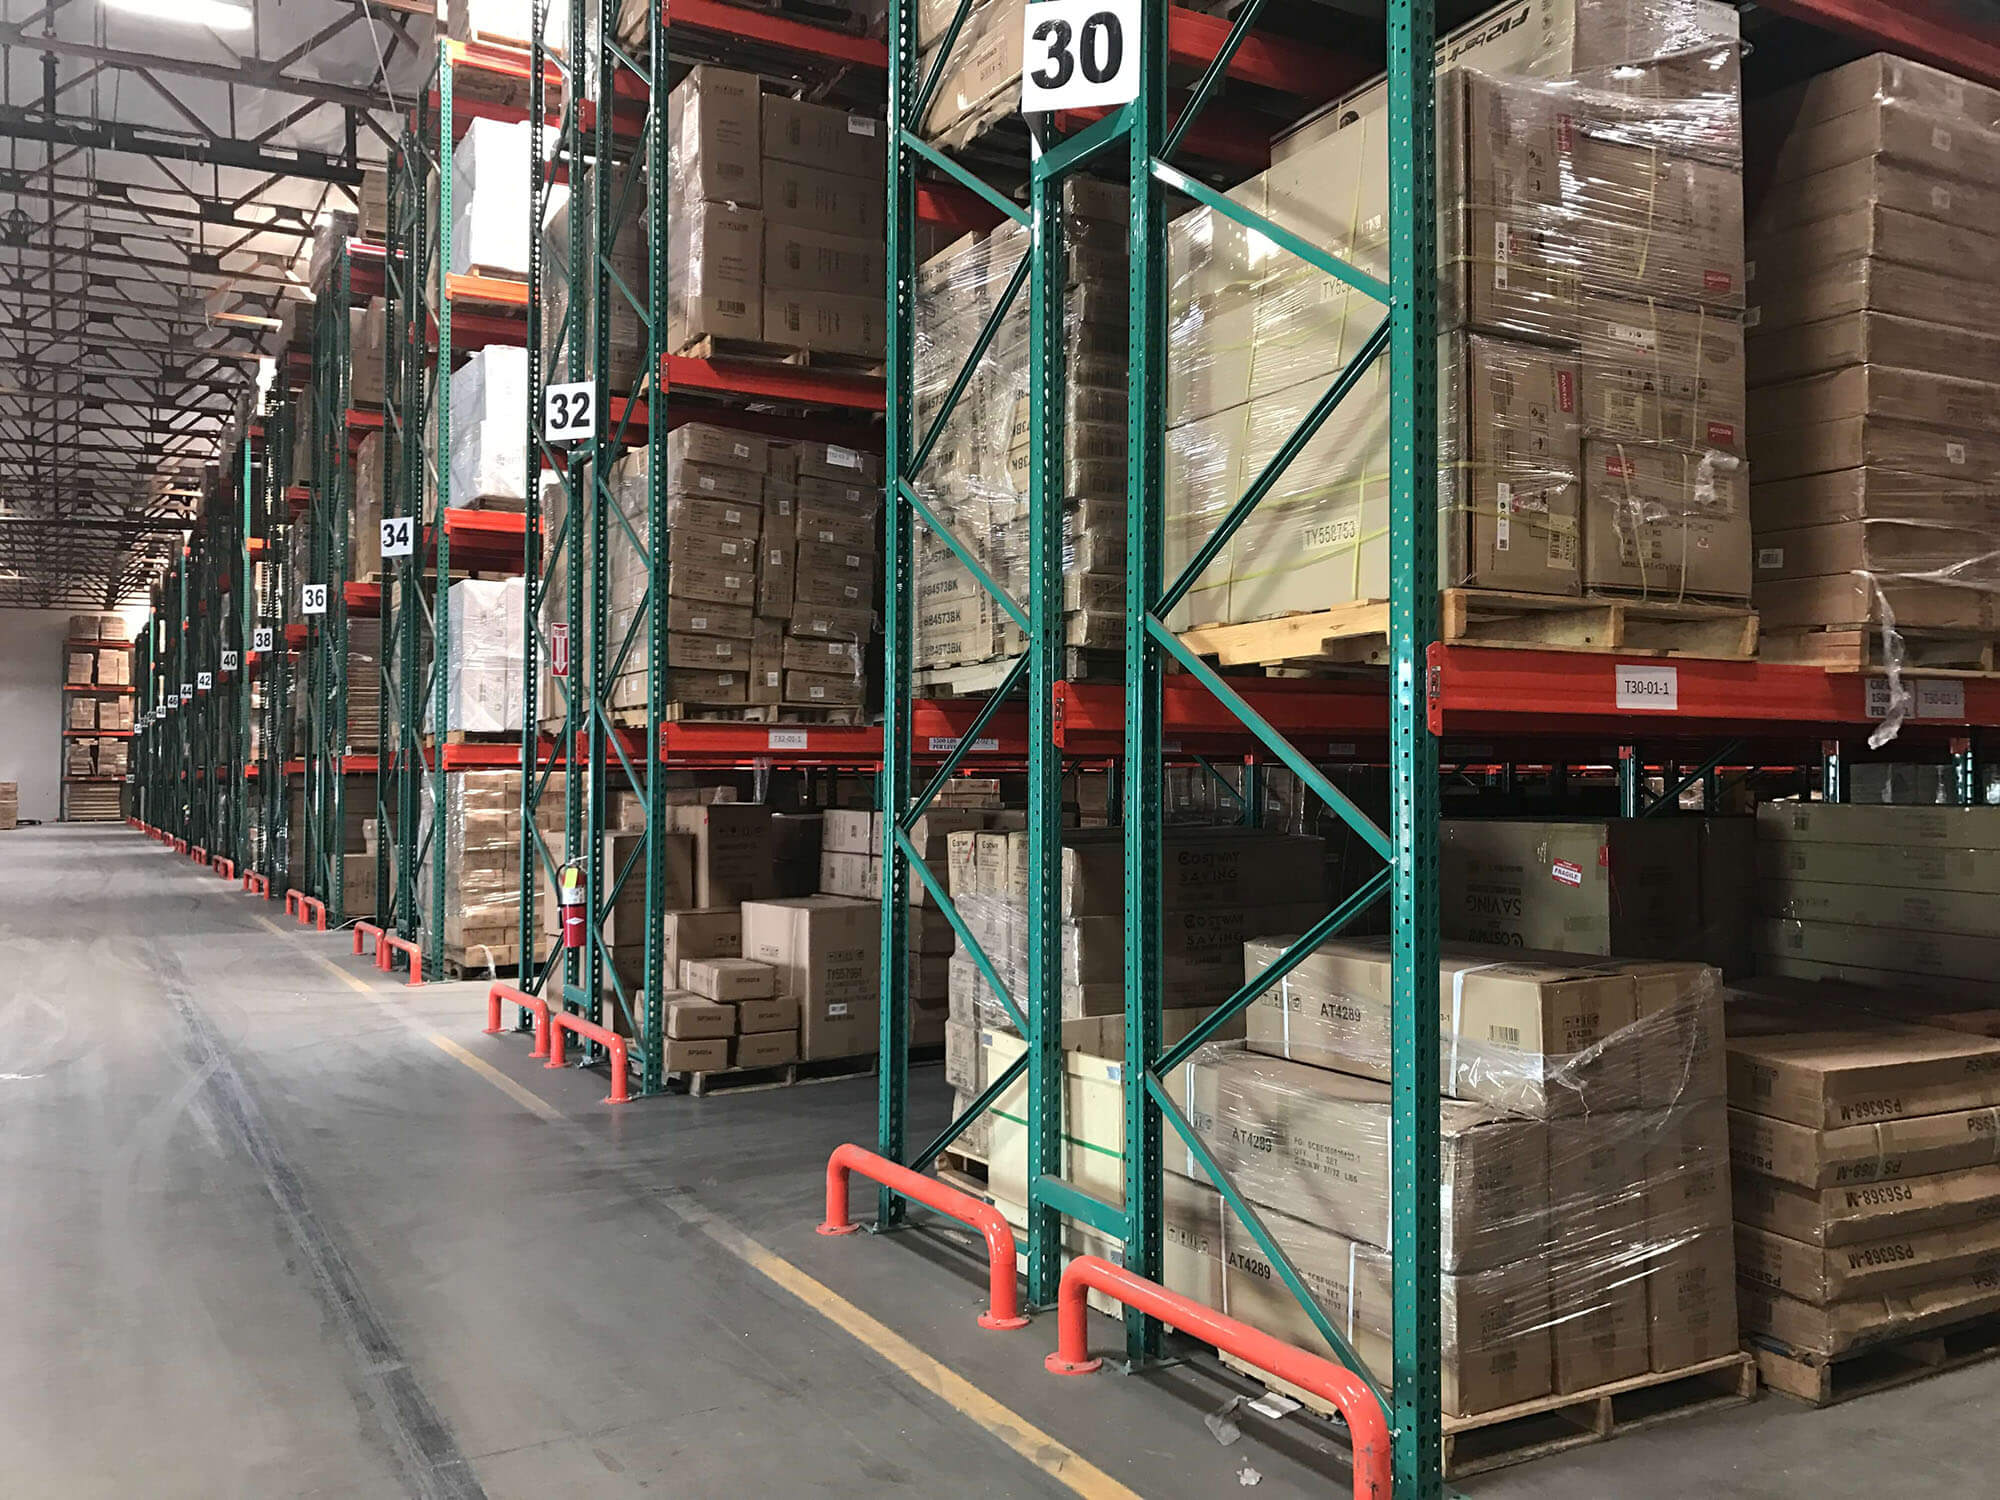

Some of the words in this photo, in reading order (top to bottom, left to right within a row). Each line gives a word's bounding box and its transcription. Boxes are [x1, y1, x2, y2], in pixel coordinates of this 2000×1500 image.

[1031, 11, 1123, 89] 30
[550, 391, 590, 429] 32
[382, 522, 409, 548] 34
[305, 589, 325, 607] 36
[255, 632, 271, 647] 38
[223, 654, 237, 666] 40
[181, 686, 192, 695] 44
[199, 674, 211, 686] 42
[1624, 680, 1669, 695] T30-01-1
[1320, 1002, 1361, 1022] AT4289
[1231, 1127, 1272, 1153] AT4289
[1846, 1185, 1913, 1208] PS6368-M
[1228, 1252, 1271, 1280] AT4289
[1848, 1243, 1914, 1269] PS6368-M
